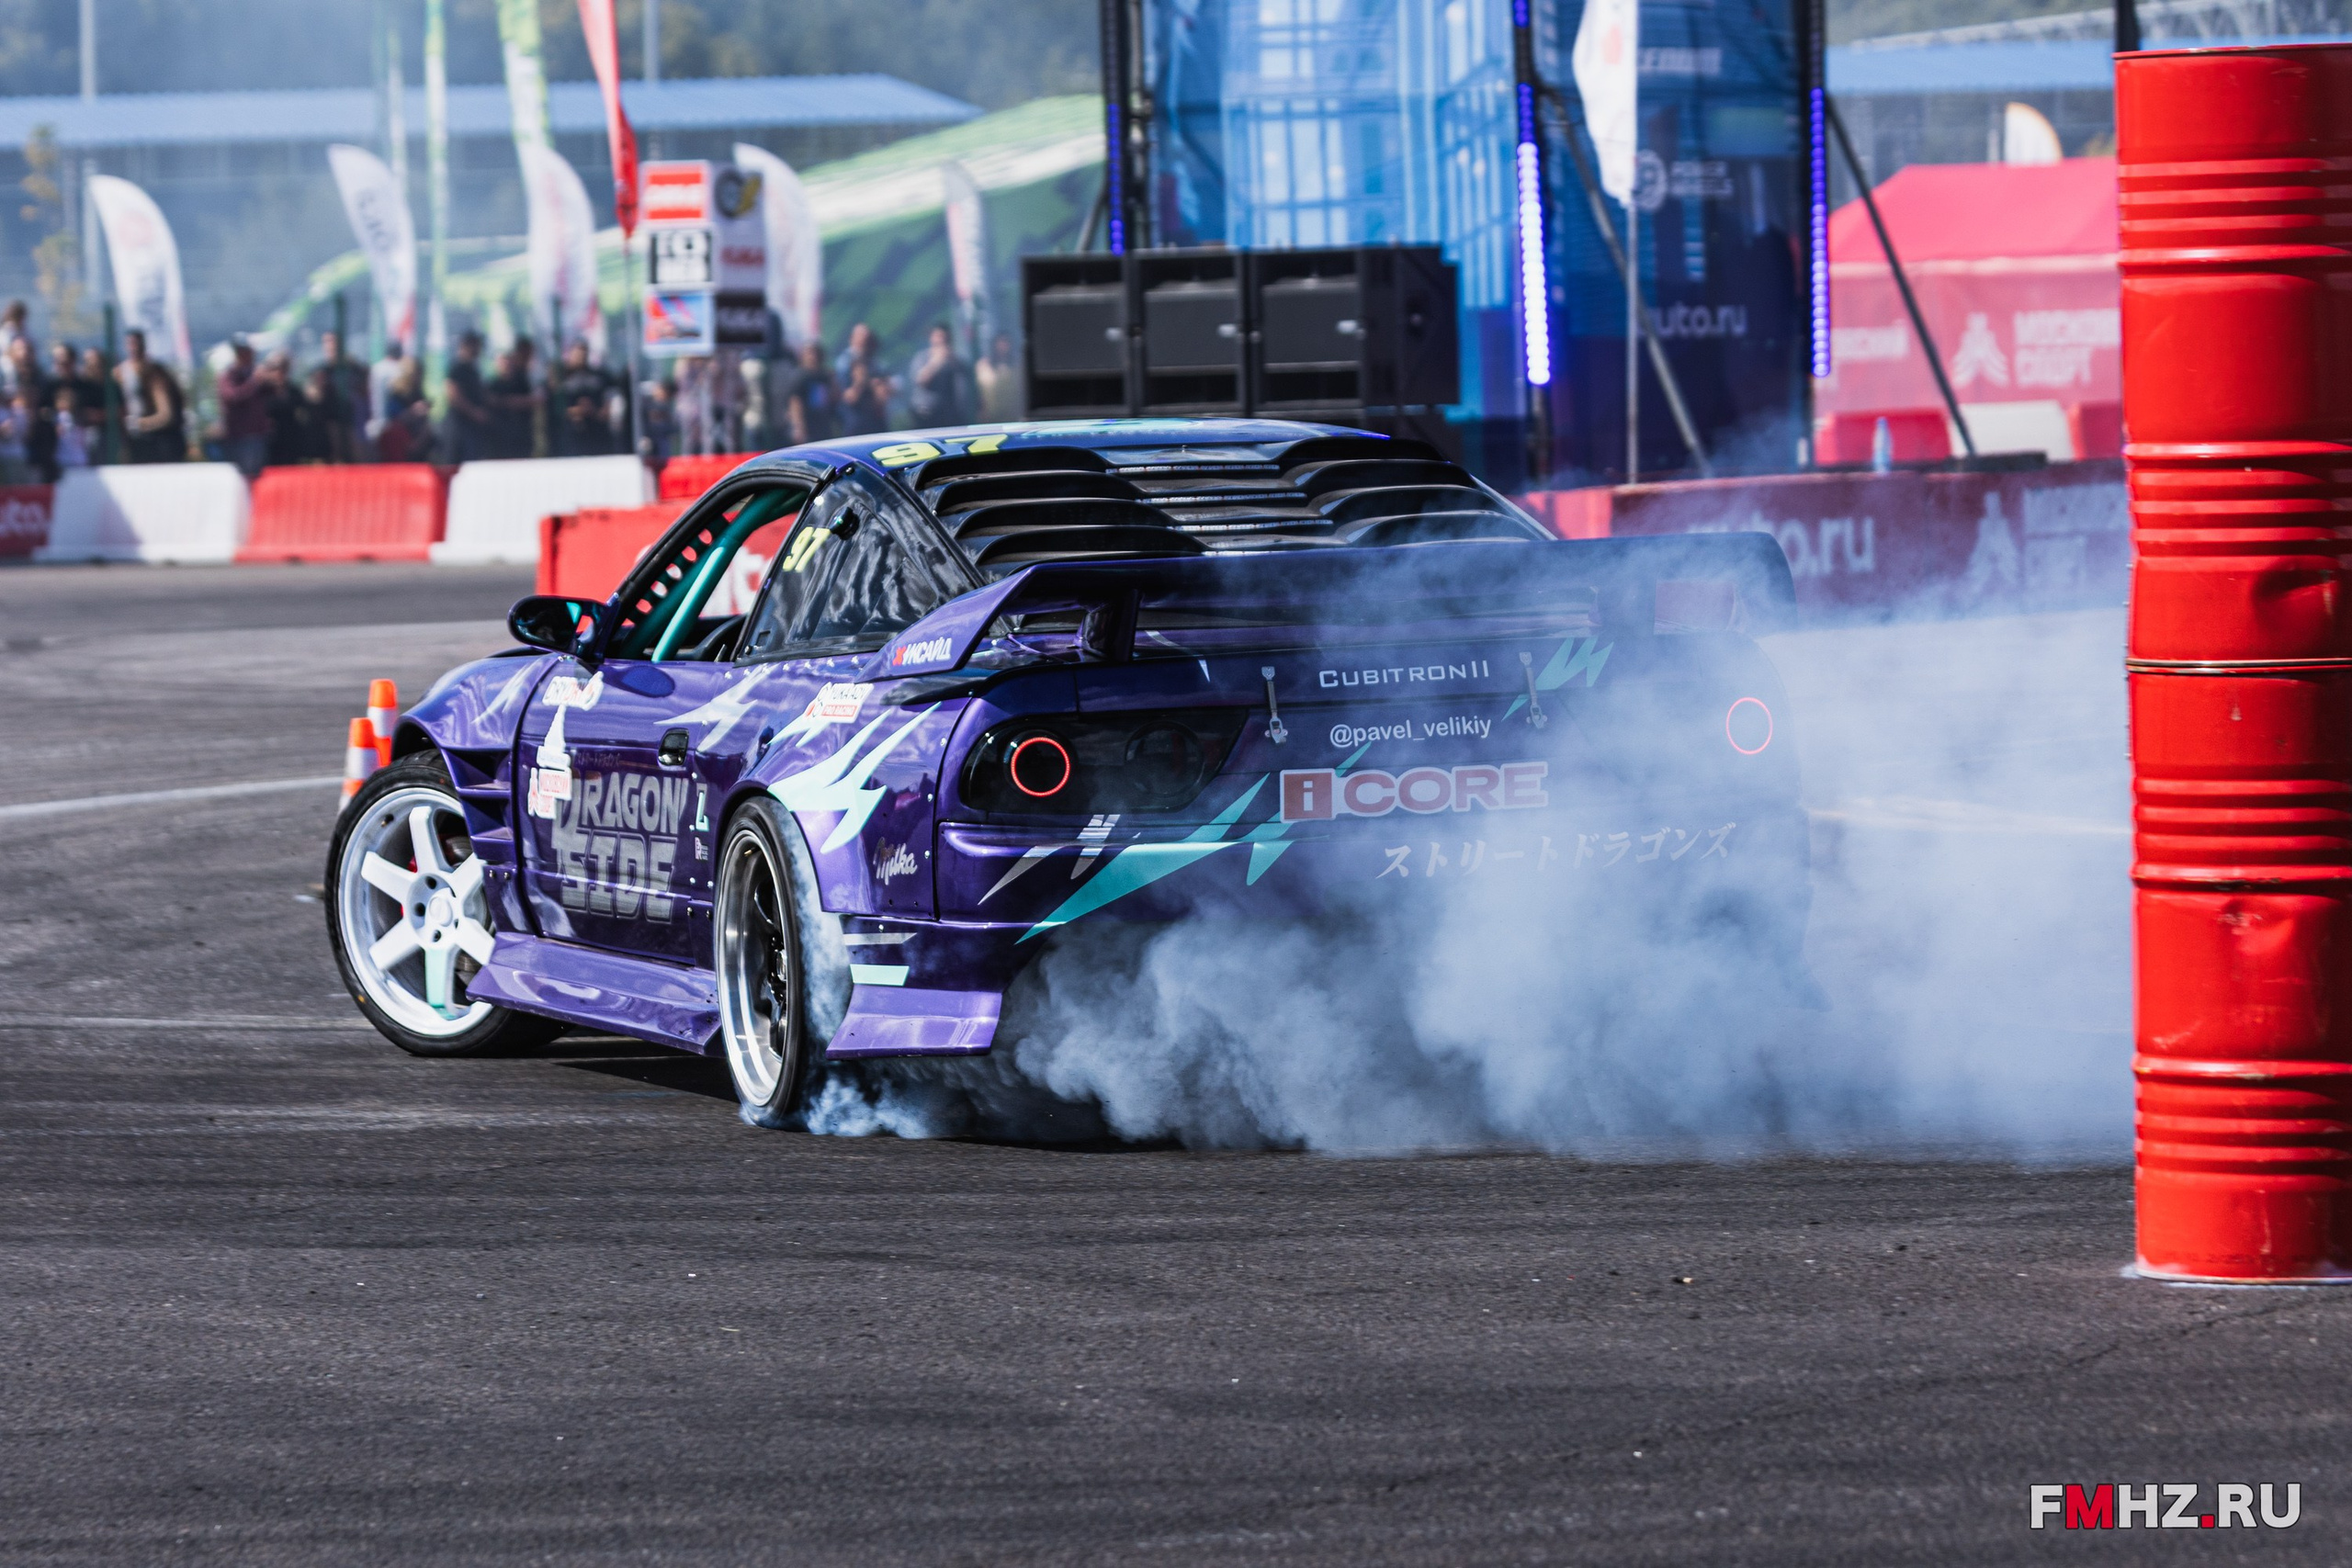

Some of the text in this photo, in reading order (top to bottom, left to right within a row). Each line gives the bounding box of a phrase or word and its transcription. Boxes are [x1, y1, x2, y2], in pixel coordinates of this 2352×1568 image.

[872, 434, 1008, 467] 97
[783, 526, 830, 572] 97
[1329, 715, 1491, 748] @pavel_velikiy
[1375, 822, 1736, 879] ストリートドラゴンズ
[557, 829, 678, 923] SIDE
